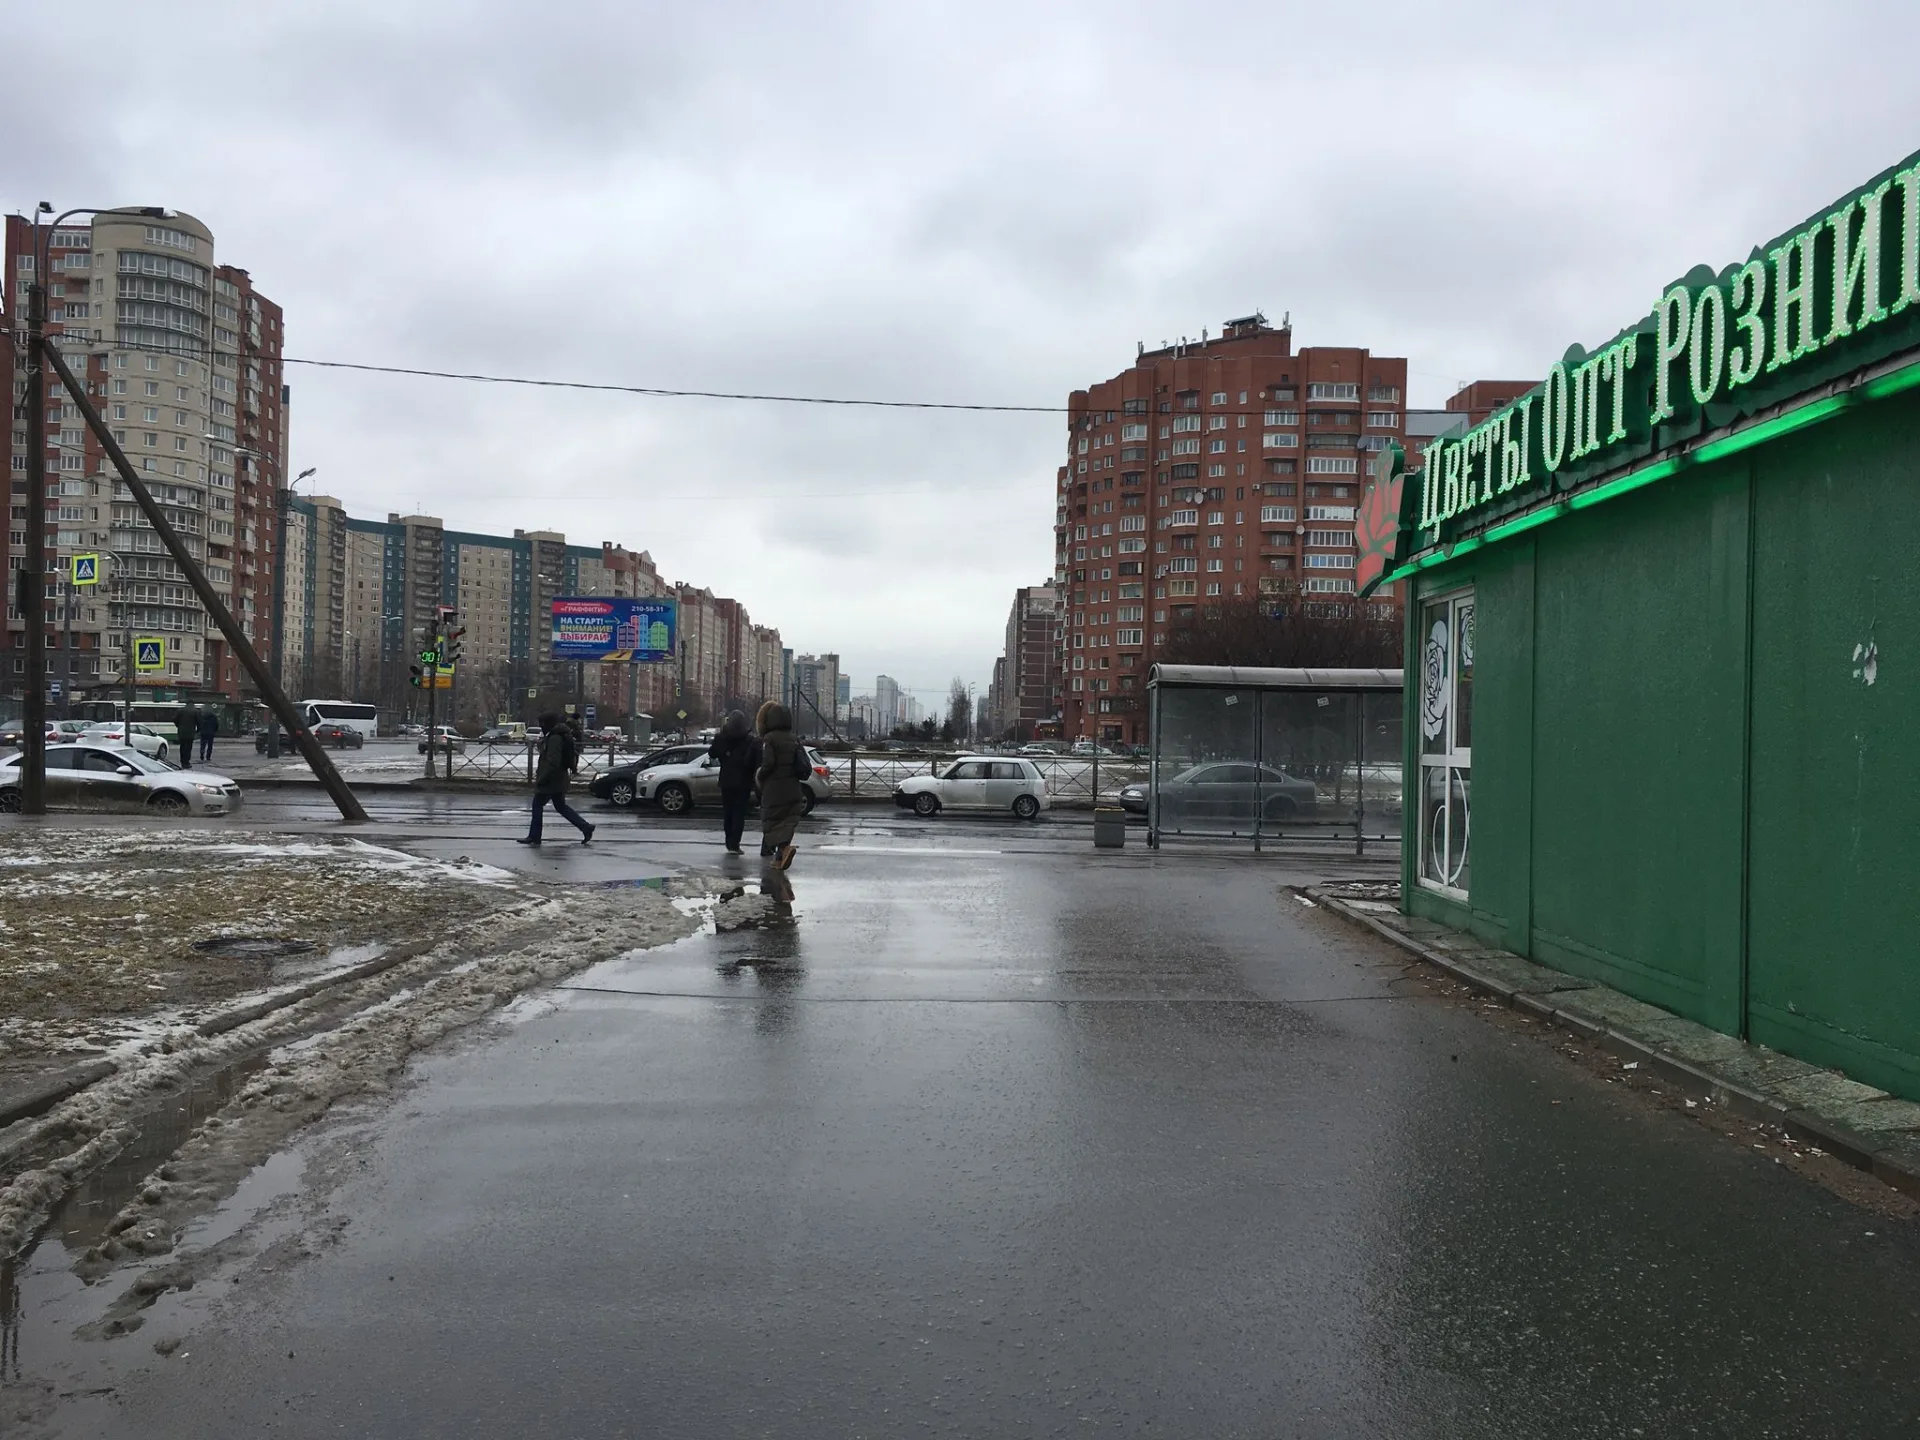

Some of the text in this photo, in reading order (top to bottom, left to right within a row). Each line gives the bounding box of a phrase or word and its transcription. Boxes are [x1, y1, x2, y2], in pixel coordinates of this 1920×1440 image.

[631, 605, 664, 613] 210-58-31
[560, 616, 604, 625] НА СТАРТ!
[560, 624, 613, 633] ВНИМАНИЕ!
